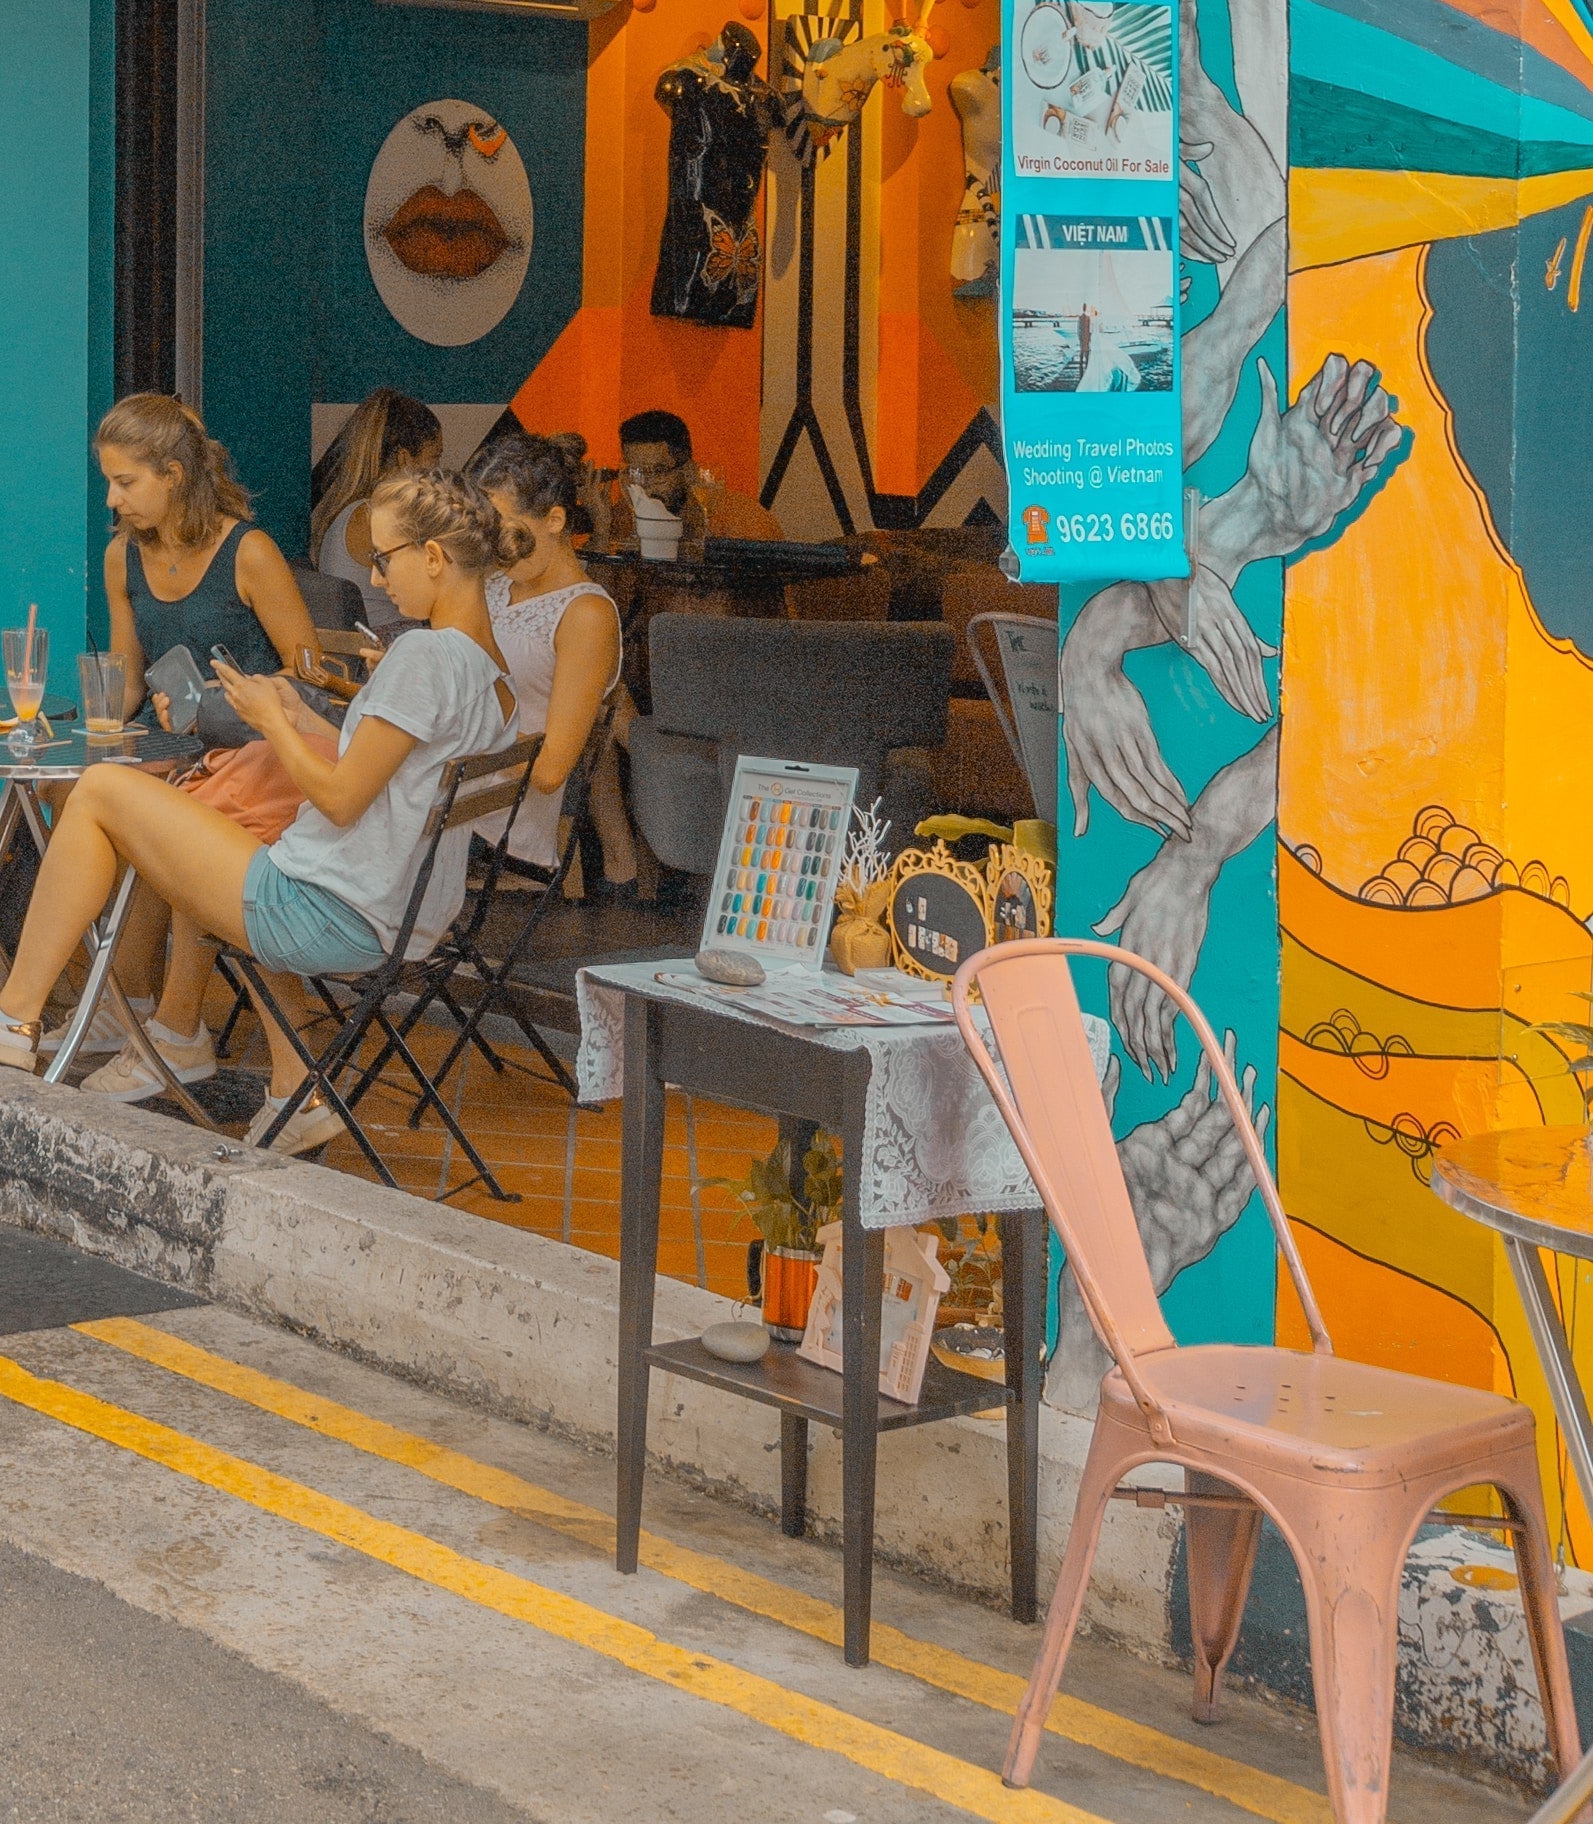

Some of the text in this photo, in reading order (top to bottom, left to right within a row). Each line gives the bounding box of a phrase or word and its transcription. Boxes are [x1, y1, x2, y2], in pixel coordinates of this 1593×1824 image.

[1018, 155, 1169, 173] Virgin Coconut Oil For Sale
[1096, 224, 1128, 244] NAM
[1013, 438, 1174, 463] Wedding Travel Photos
[1023, 465, 1164, 489] Shooting @ Vietnam
[1057, 512, 1174, 543] 9623 6866
